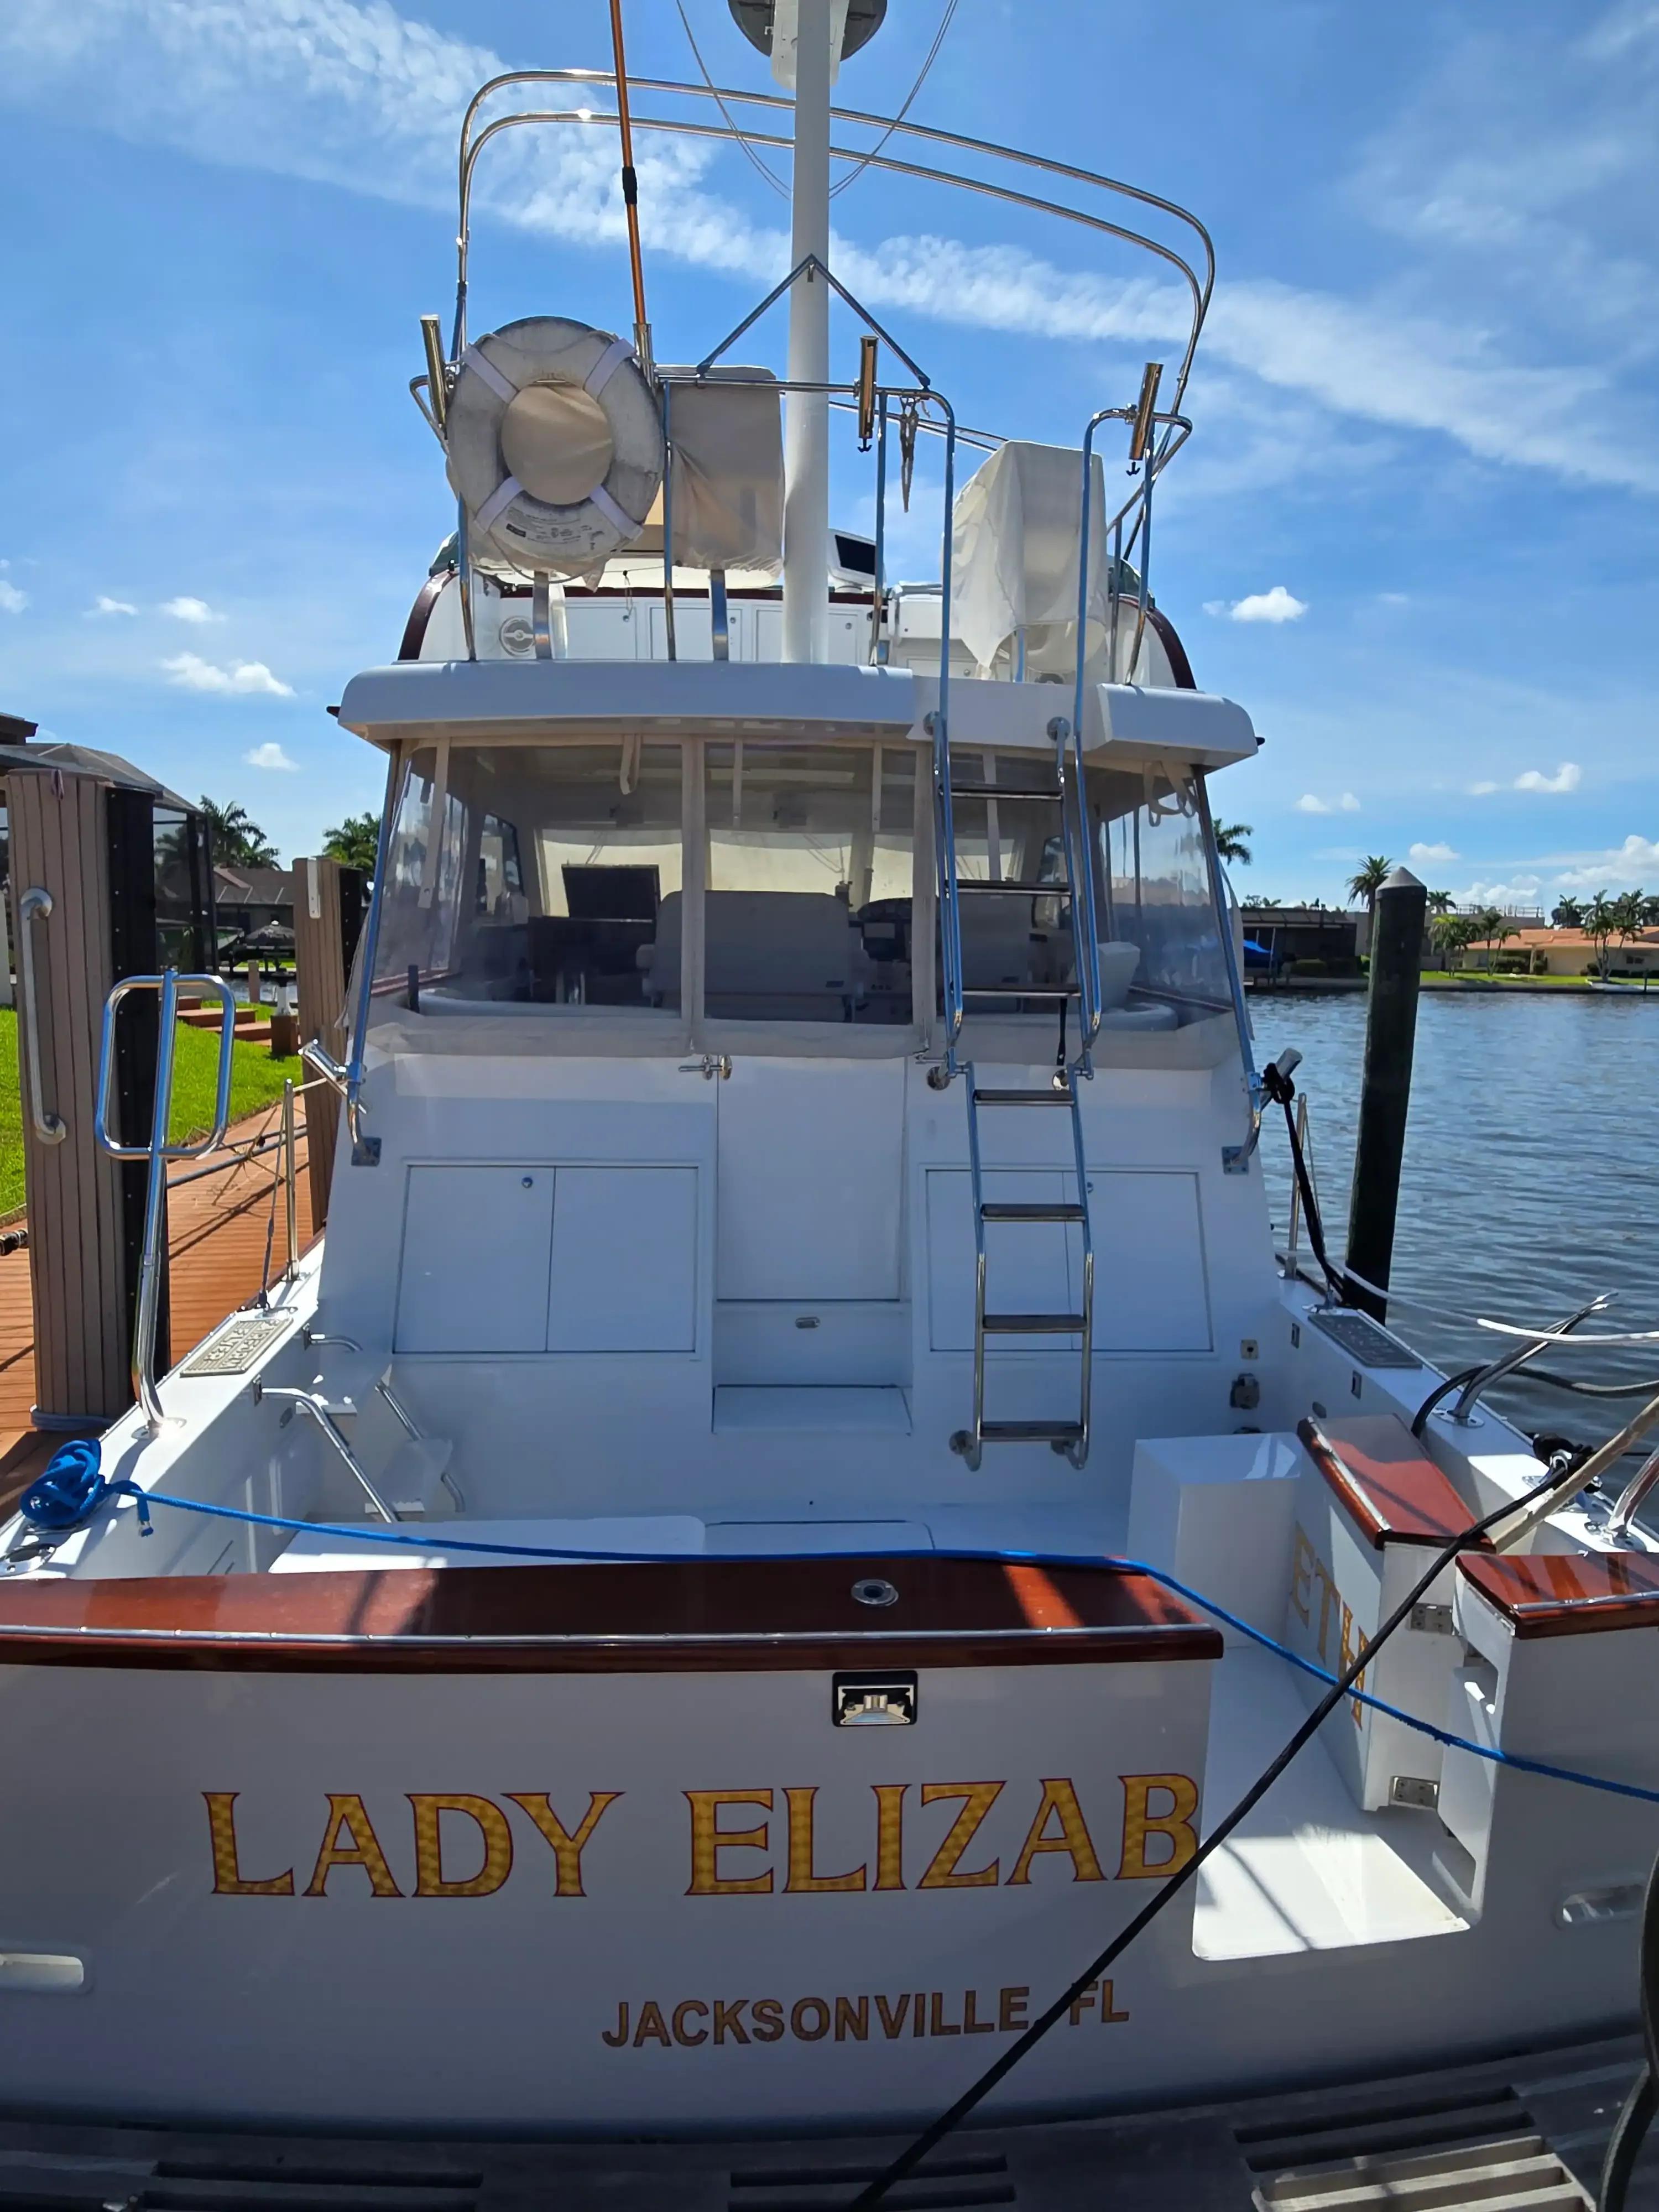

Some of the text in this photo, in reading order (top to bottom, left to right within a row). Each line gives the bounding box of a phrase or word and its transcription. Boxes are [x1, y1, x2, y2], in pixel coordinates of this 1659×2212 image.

[201, 1773, 1199, 1897] LADY ELIZAB
[601, 1979, 1129, 2048] JACKSONVILLE FL
